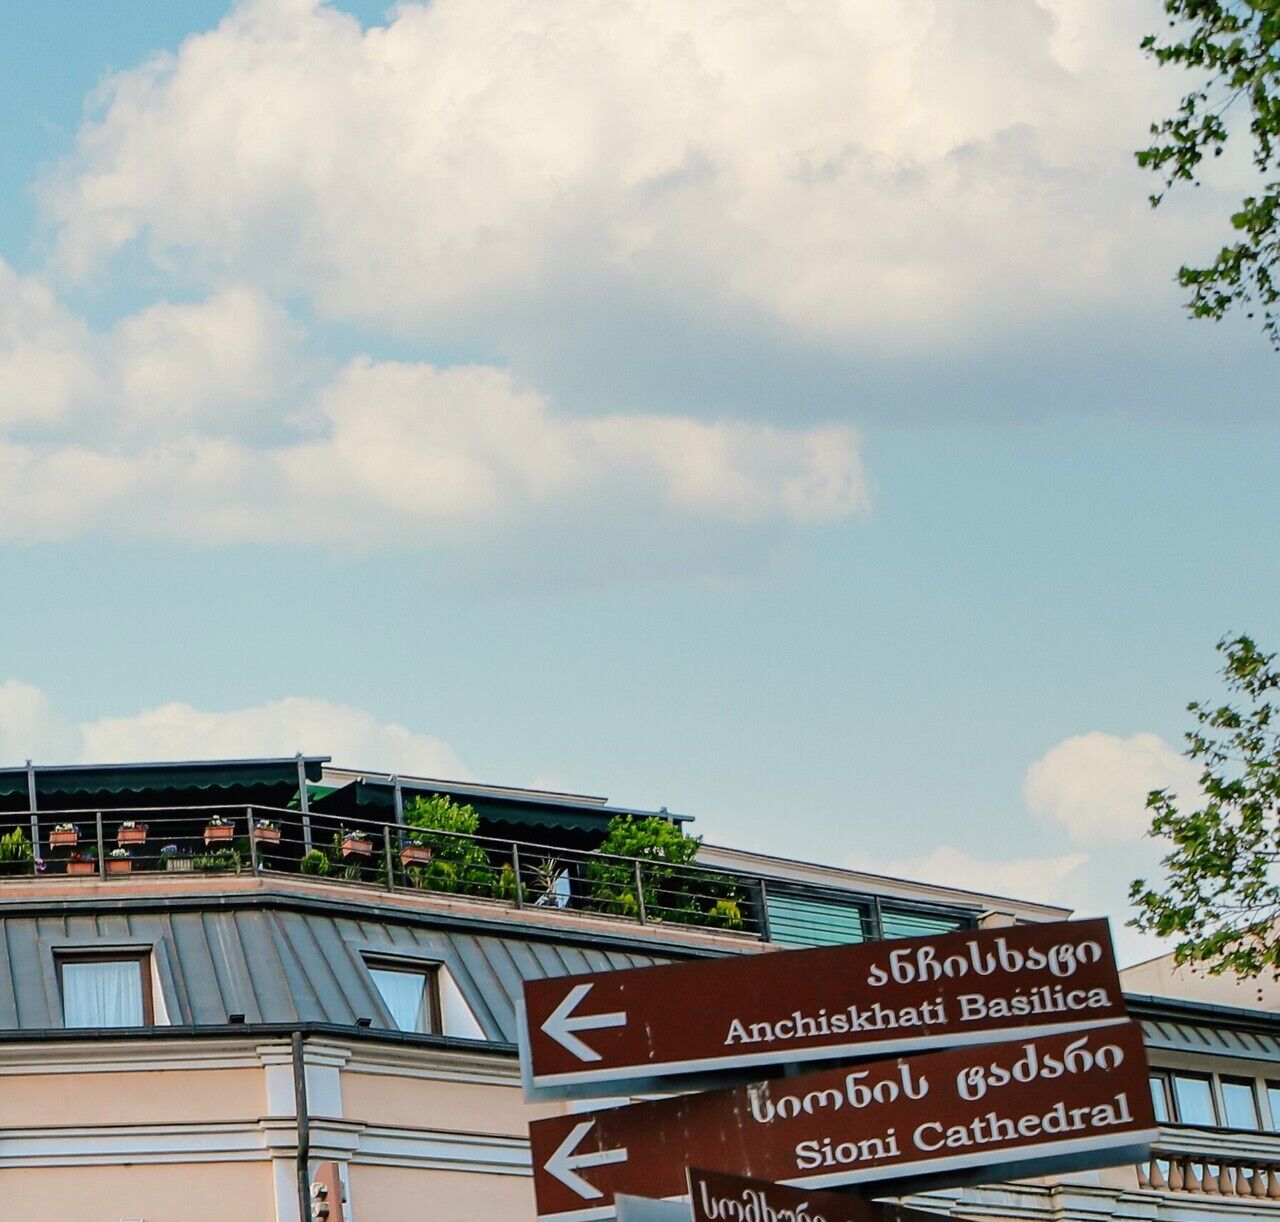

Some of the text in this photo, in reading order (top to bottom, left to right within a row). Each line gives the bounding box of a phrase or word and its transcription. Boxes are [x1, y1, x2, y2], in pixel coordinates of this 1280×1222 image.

[867, 937, 1102, 987] ანჩისხატი
[723, 984, 1112, 1045] Anchiskhati Basilica
[748, 1035, 1125, 1124] სიონის ტაძარი
[795, 1092, 1134, 1170] Sioni Cathedral
